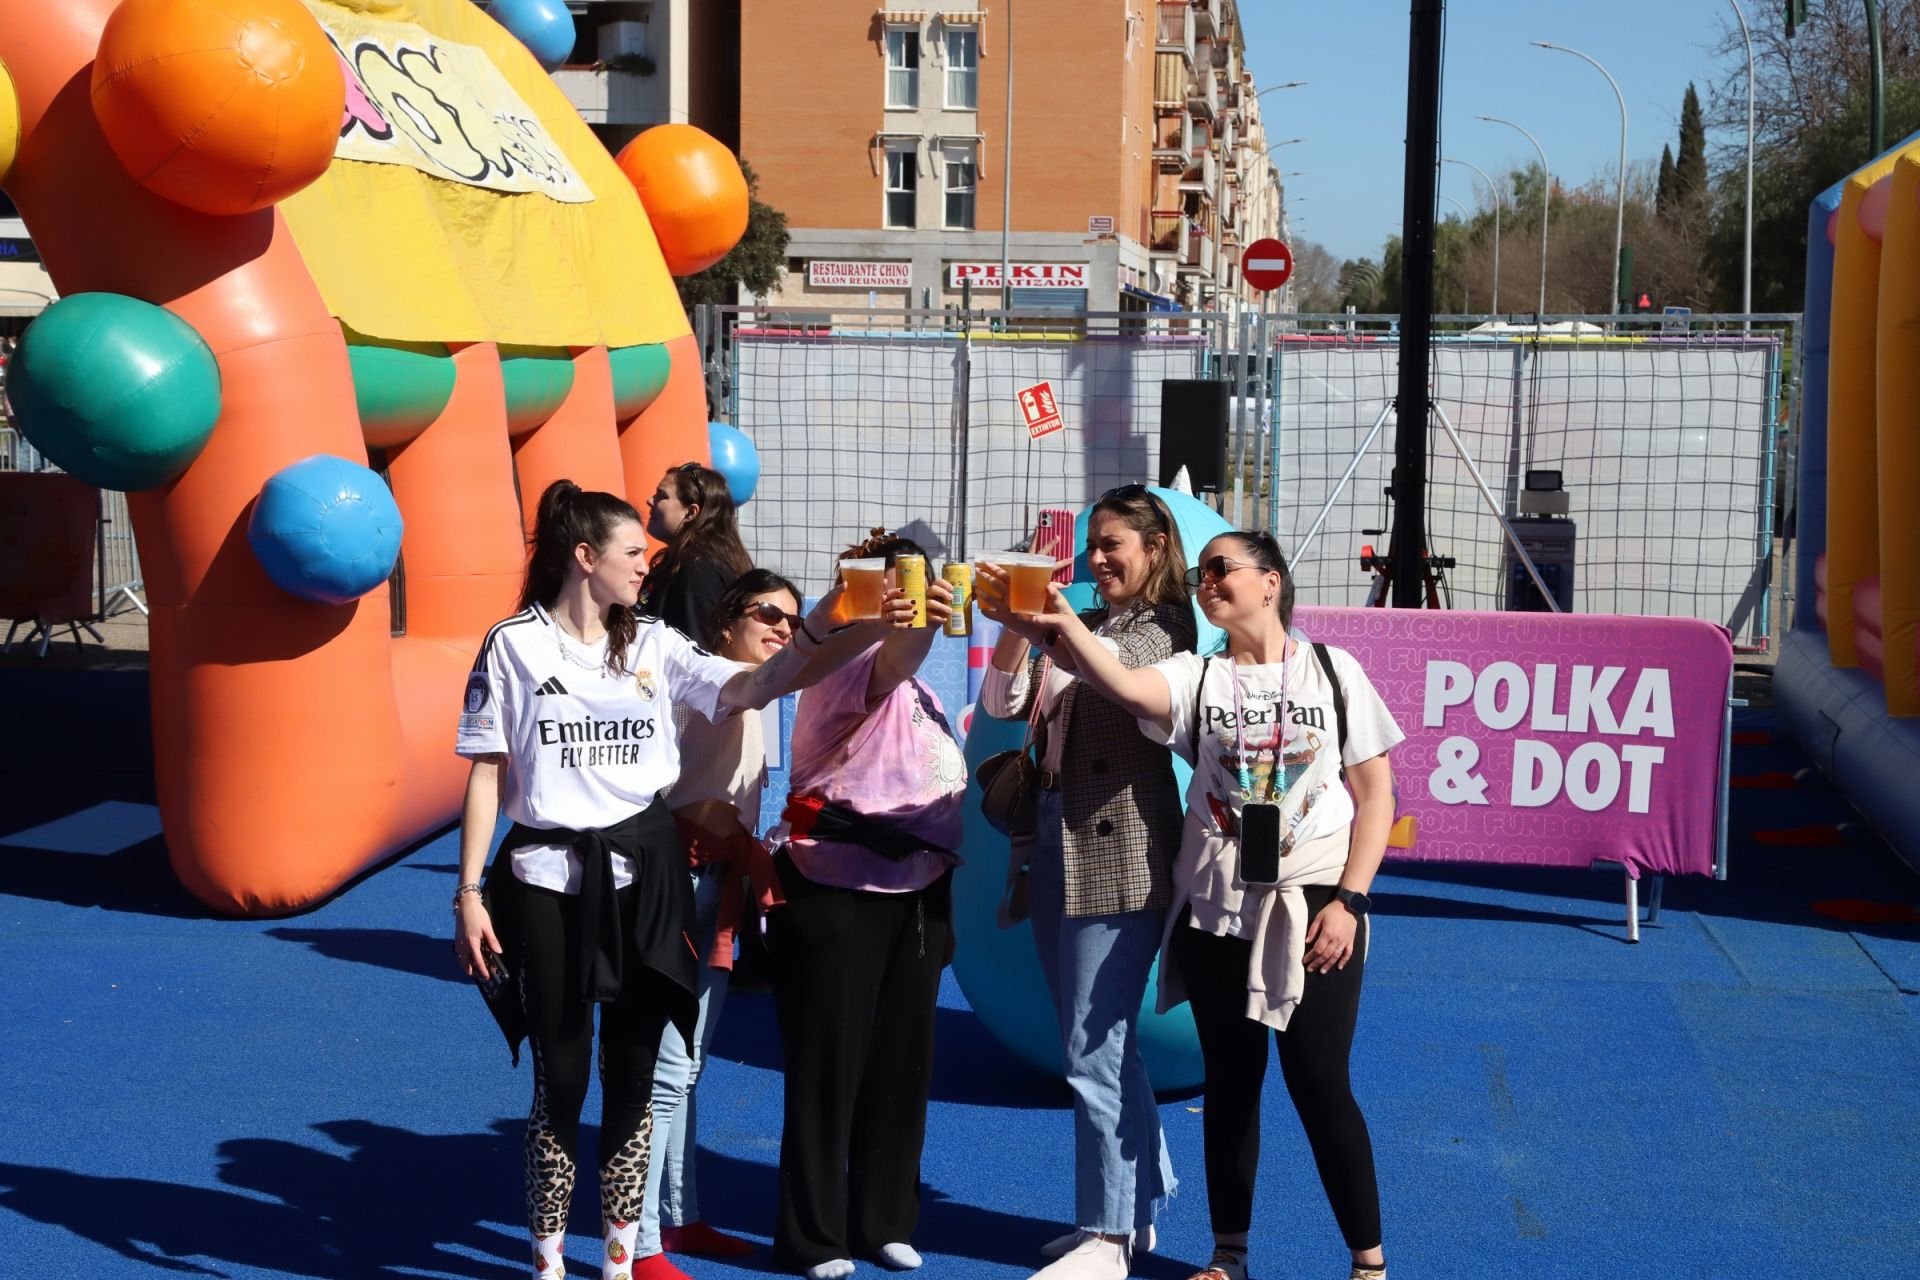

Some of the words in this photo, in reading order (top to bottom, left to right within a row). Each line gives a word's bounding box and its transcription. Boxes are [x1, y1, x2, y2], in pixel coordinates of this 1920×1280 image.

[813, 263, 877, 276] RESTAURANTE
[879, 264, 909, 277] CHINO
[814, 277, 846, 285] SALON
[849, 277, 908, 286] REUNIONES
[956, 265, 1084, 279] PEKIN
[1423, 660, 1676, 738] POLKA
[537, 715, 655, 746] Emirates
[1205, 705, 1271, 735] Peter
[1273, 700, 1326, 732] Pan
[560, 747, 582, 769] FLY
[588, 744, 640, 767] BETTER
[1428, 736, 1490, 805] &
[1511, 739, 1665, 814] DOT
